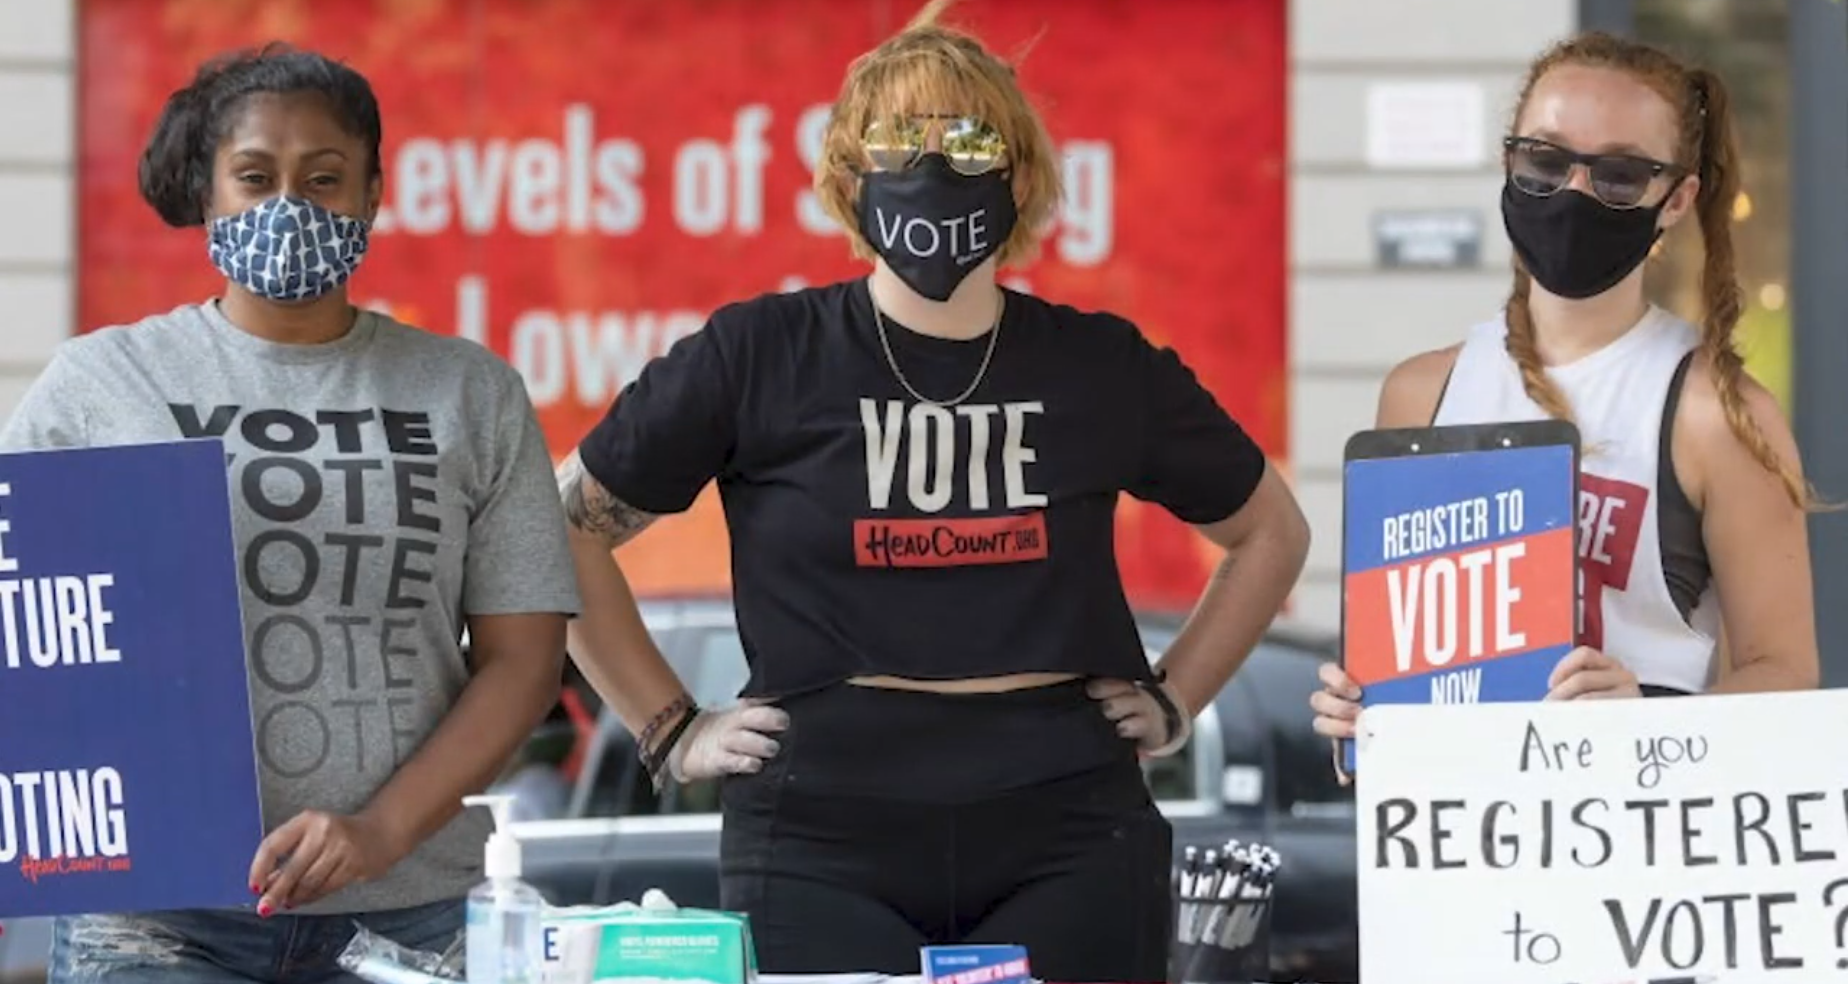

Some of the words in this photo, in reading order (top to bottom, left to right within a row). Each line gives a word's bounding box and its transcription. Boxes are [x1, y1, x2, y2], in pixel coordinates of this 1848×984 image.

[372, 103, 645, 236] evels
[673, 103, 772, 236] of
[876, 207, 987, 258] VOTE
[456, 274, 705, 407] Low
[168, 402, 438, 455] VOTE
[859, 398, 1048, 513] VOTE
[228, 453, 440, 533] OTE
[1383, 496, 1489, 560] REGISTER
[1495, 488, 1524, 535] TO
[1579, 489, 1627, 566] RE
[1386, 542, 1526, 673] VOTE
[1431, 667, 1483, 705] NOW
[1519, 720, 1593, 772] Are
[1636, 733, 1708, 789] you
[1374, 789, 1848, 871] REGISTERE
[1502, 911, 1561, 965] to
